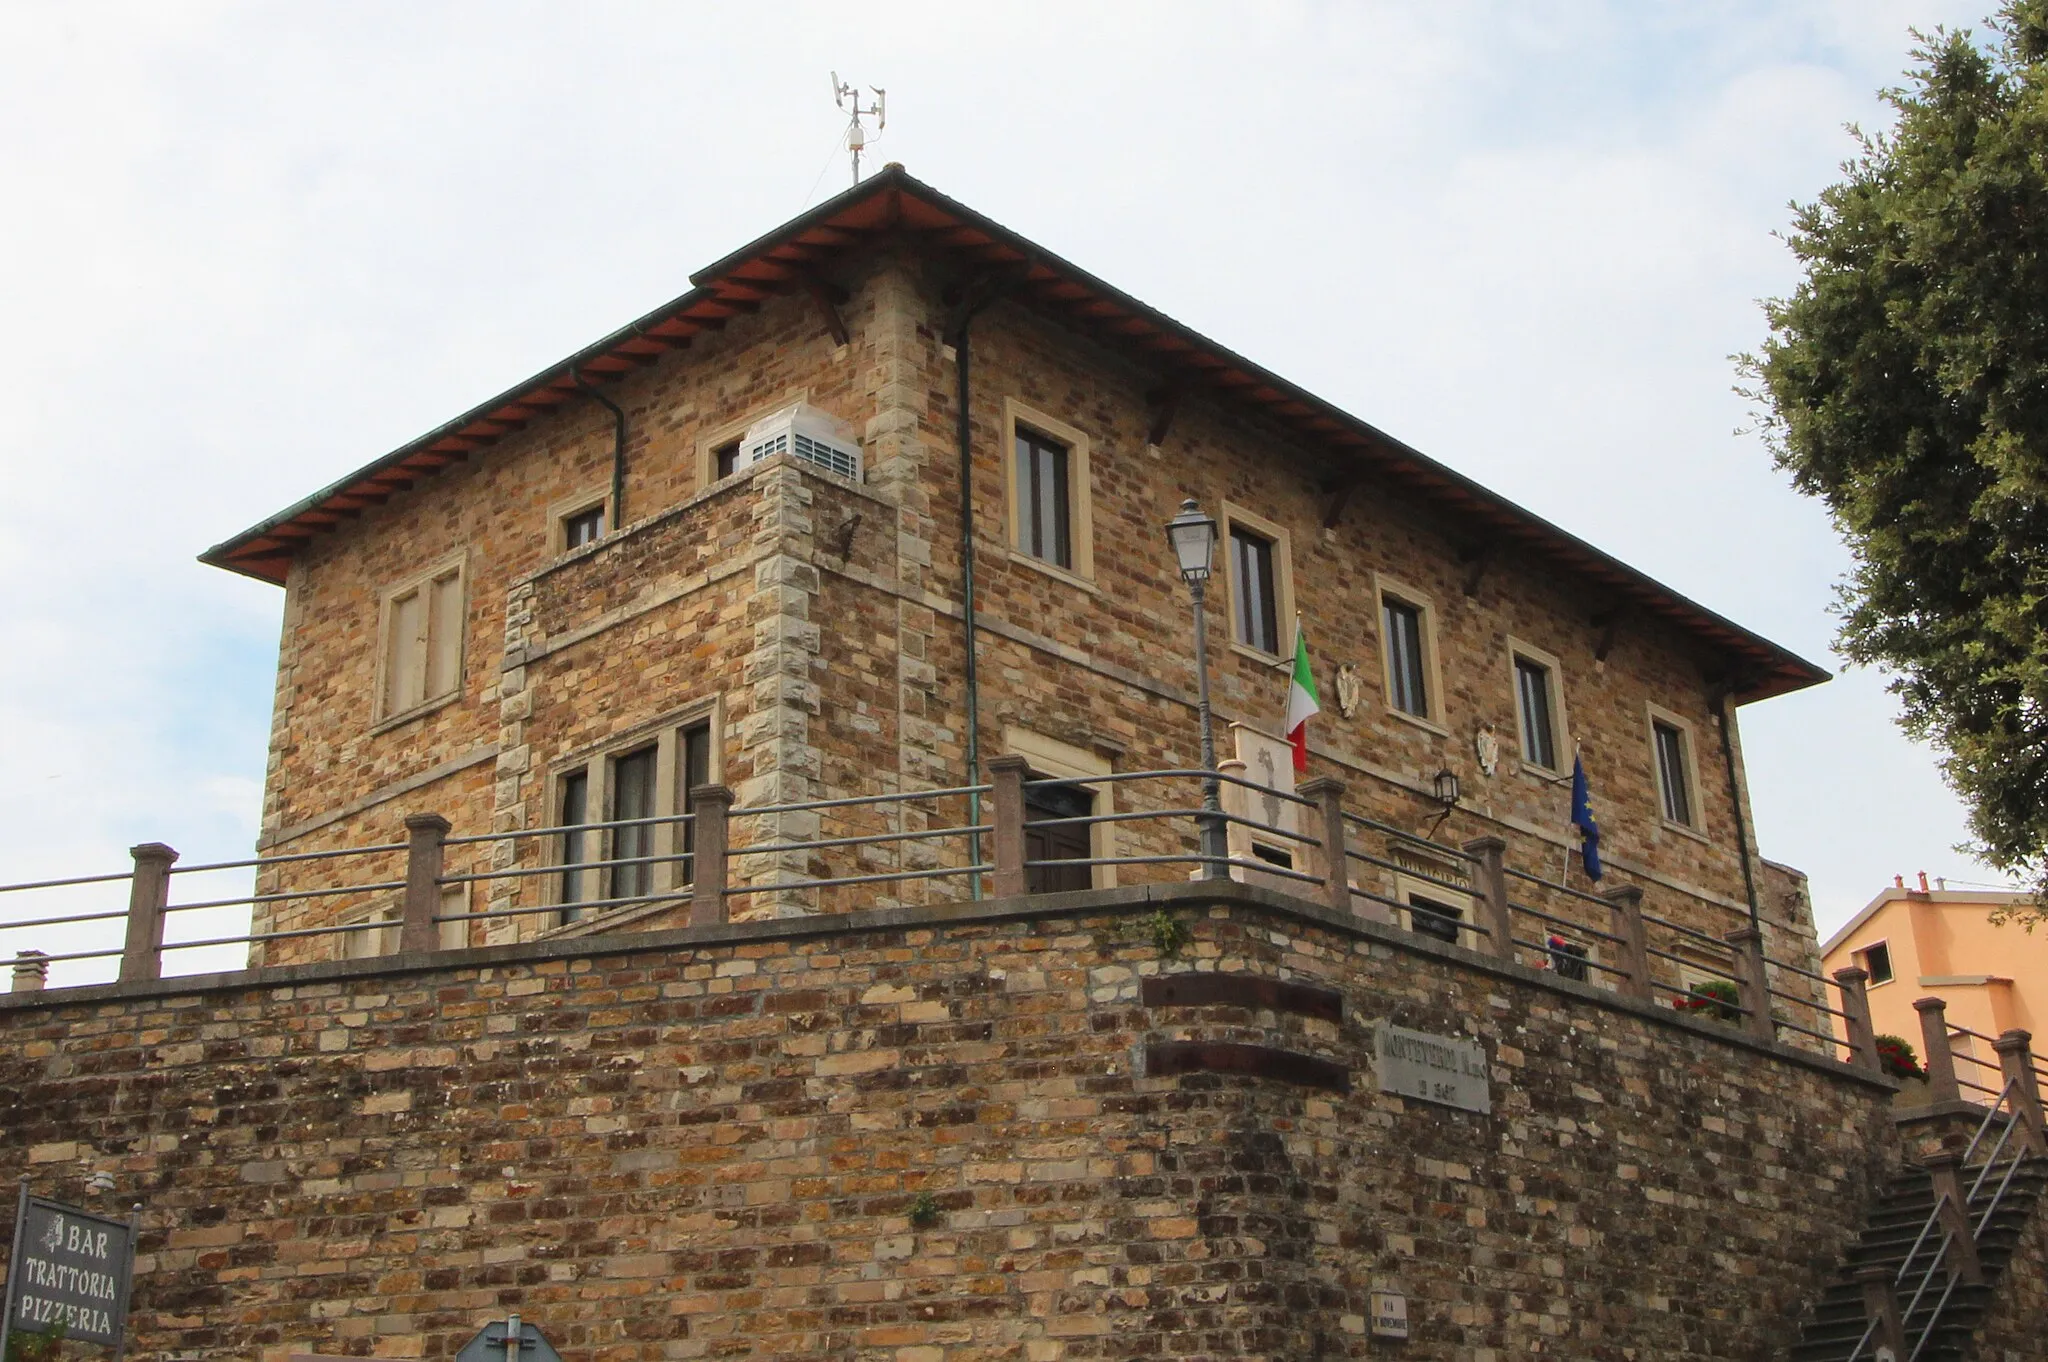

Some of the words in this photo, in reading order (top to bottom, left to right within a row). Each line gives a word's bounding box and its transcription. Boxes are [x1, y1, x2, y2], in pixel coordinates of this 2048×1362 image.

[67, 1225, 108, 1259] BAR
[26, 1257, 115, 1300] TRATTORIA
[21, 1295, 111, 1335] PIZZERIA
[1383, 1301, 1394, 1312] VIA
